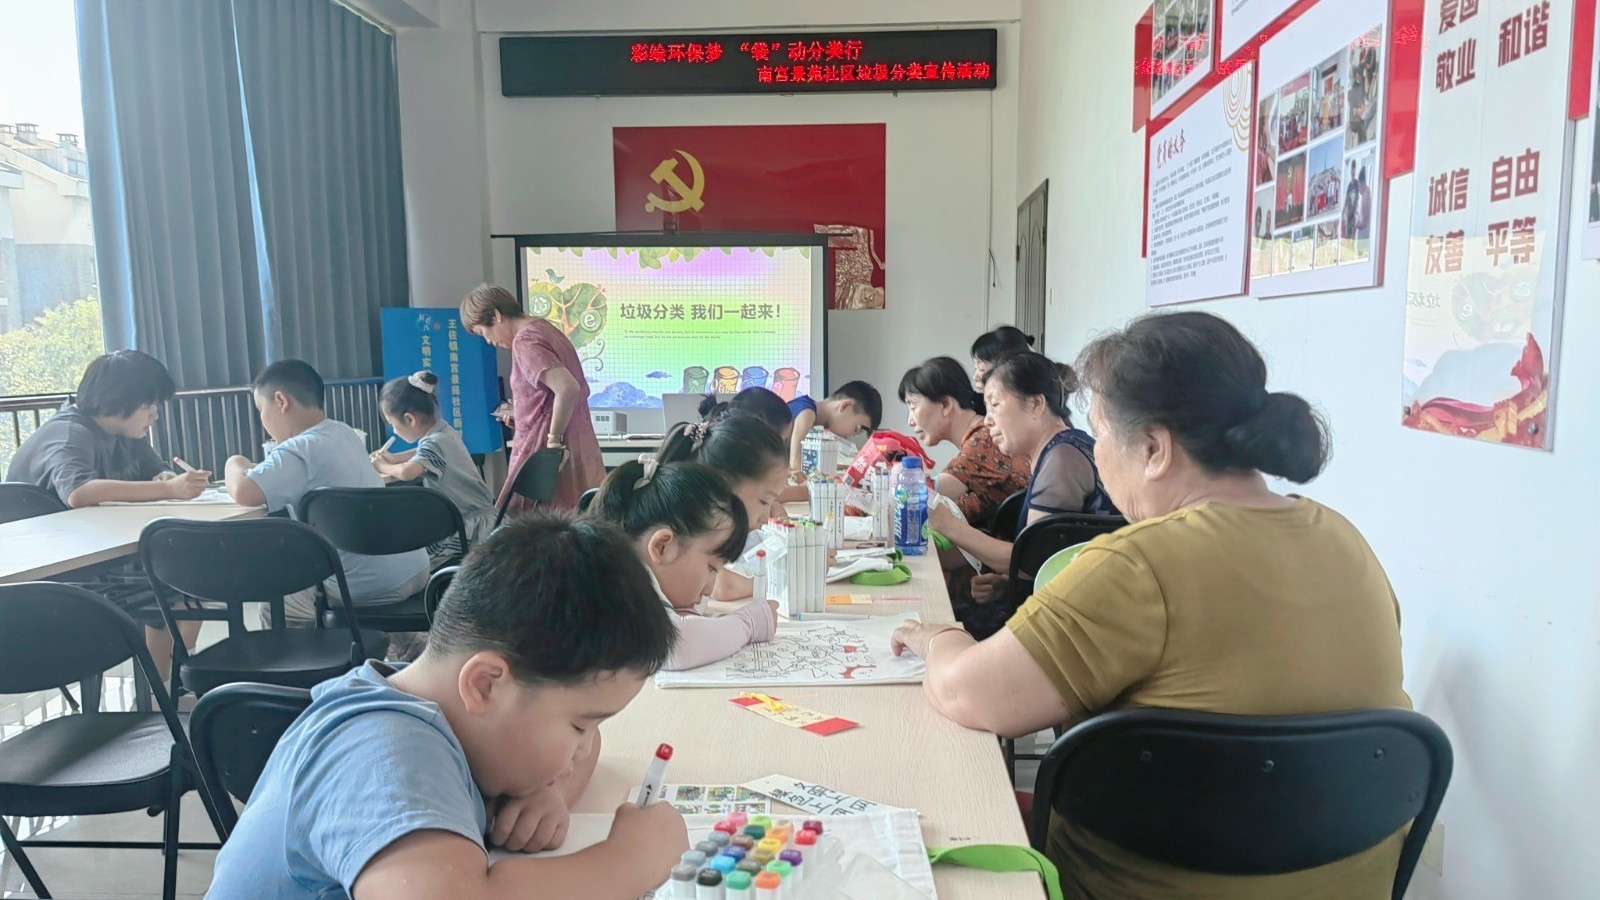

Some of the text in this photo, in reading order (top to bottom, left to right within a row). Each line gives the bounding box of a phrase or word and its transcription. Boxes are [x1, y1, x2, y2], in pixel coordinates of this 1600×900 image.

[630, 42, 723, 63] 彩绘环保梦
[1497, 1, 1550, 67] 和谐
[757, 61, 990, 83] 南宫景苑社区垃圾分类宣传活动
[1435, 38, 1478, 93] 敬业
[1428, 168, 1470, 216] 诚信
[1490, 147, 1540, 203] 自由
[1424, 229, 1465, 275] 友善
[1486, 216, 1536, 267] 平等
[620, 303, 781, 320] 垃圾分类 我们一起来！
[420, 335, 433, 372] 文明实
